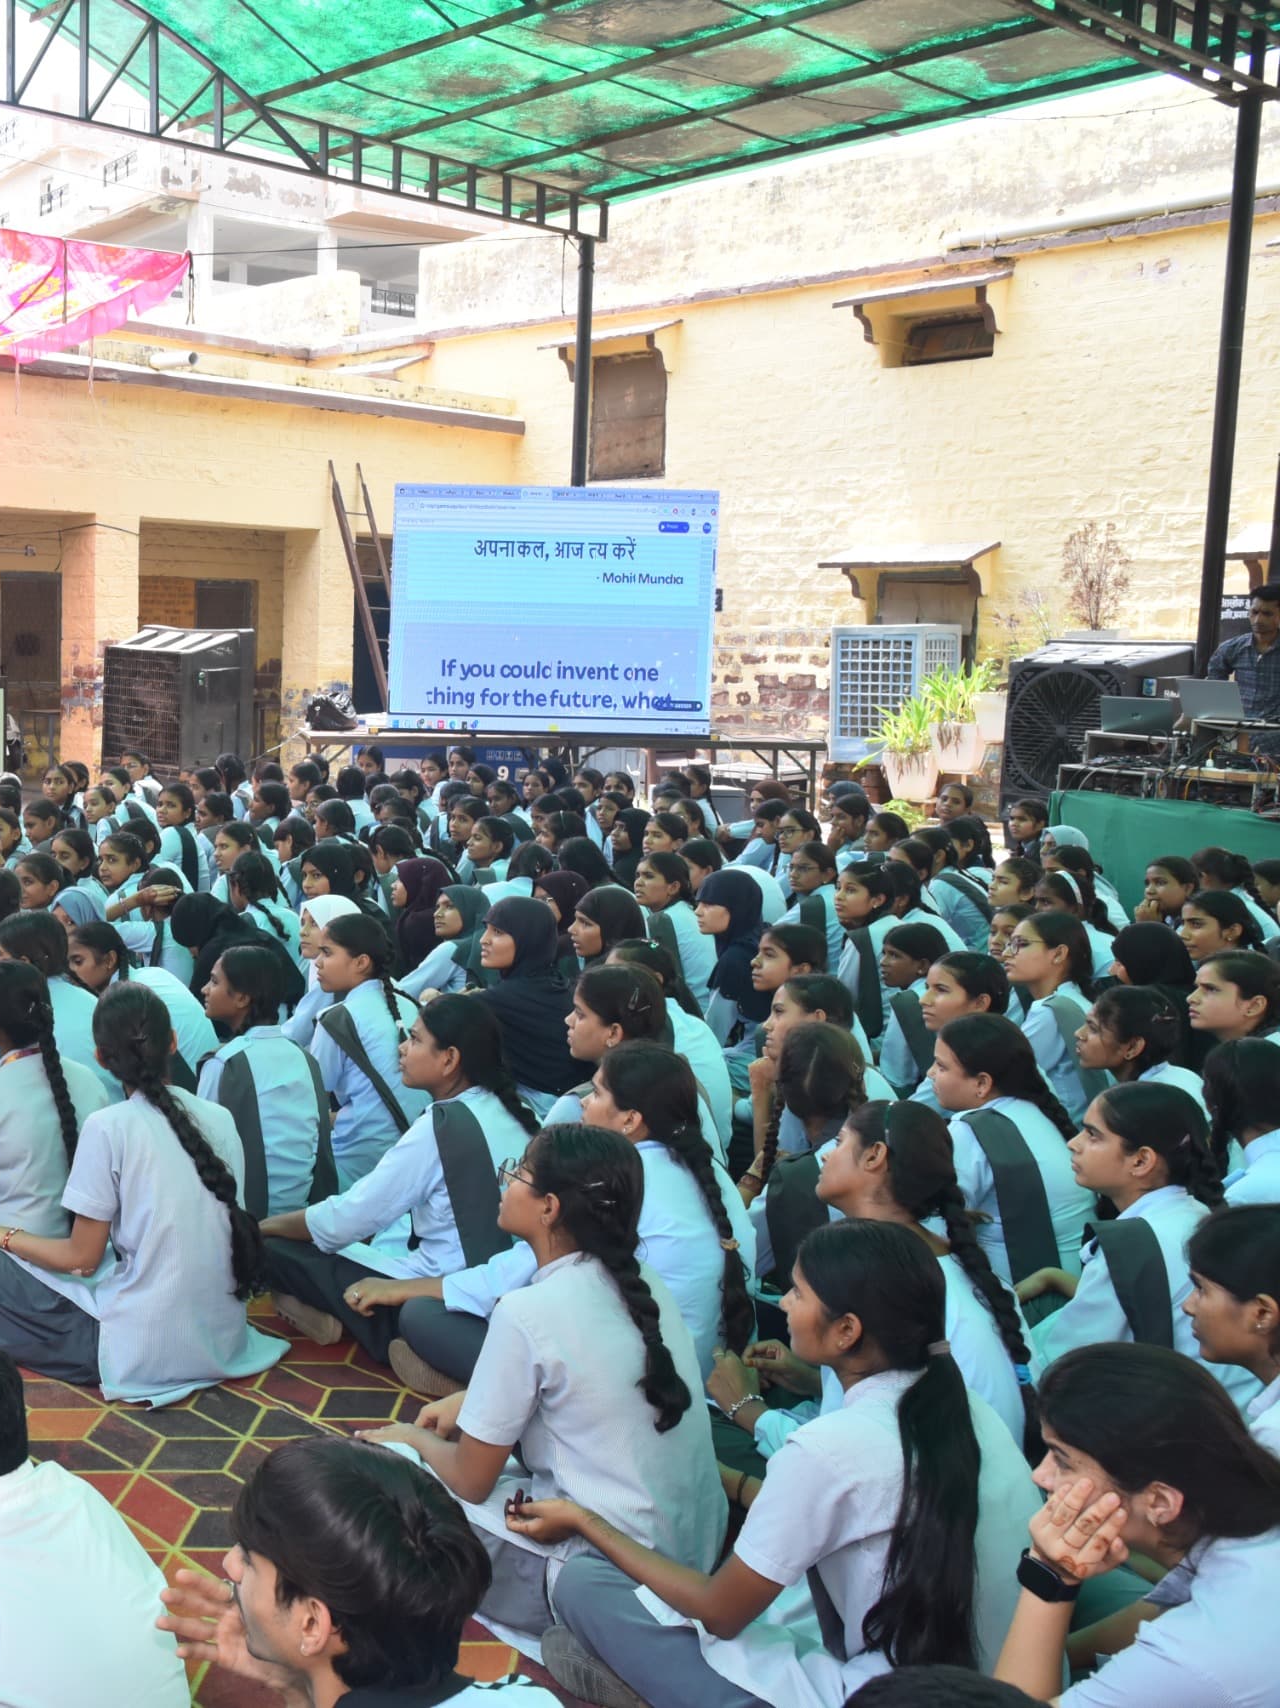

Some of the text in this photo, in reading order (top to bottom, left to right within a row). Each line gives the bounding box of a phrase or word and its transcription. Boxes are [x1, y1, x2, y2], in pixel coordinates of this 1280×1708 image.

[555, 541, 584, 559] आज
[612, 536, 636, 560] करें
[441, 659, 659, 681] If you could invent one
[426, 686, 475, 709] thing
[480, 688, 511, 706] for
[513, 689, 547, 707] the
[550, 689, 618, 711] future,
[496, 765, 509, 781] 9
